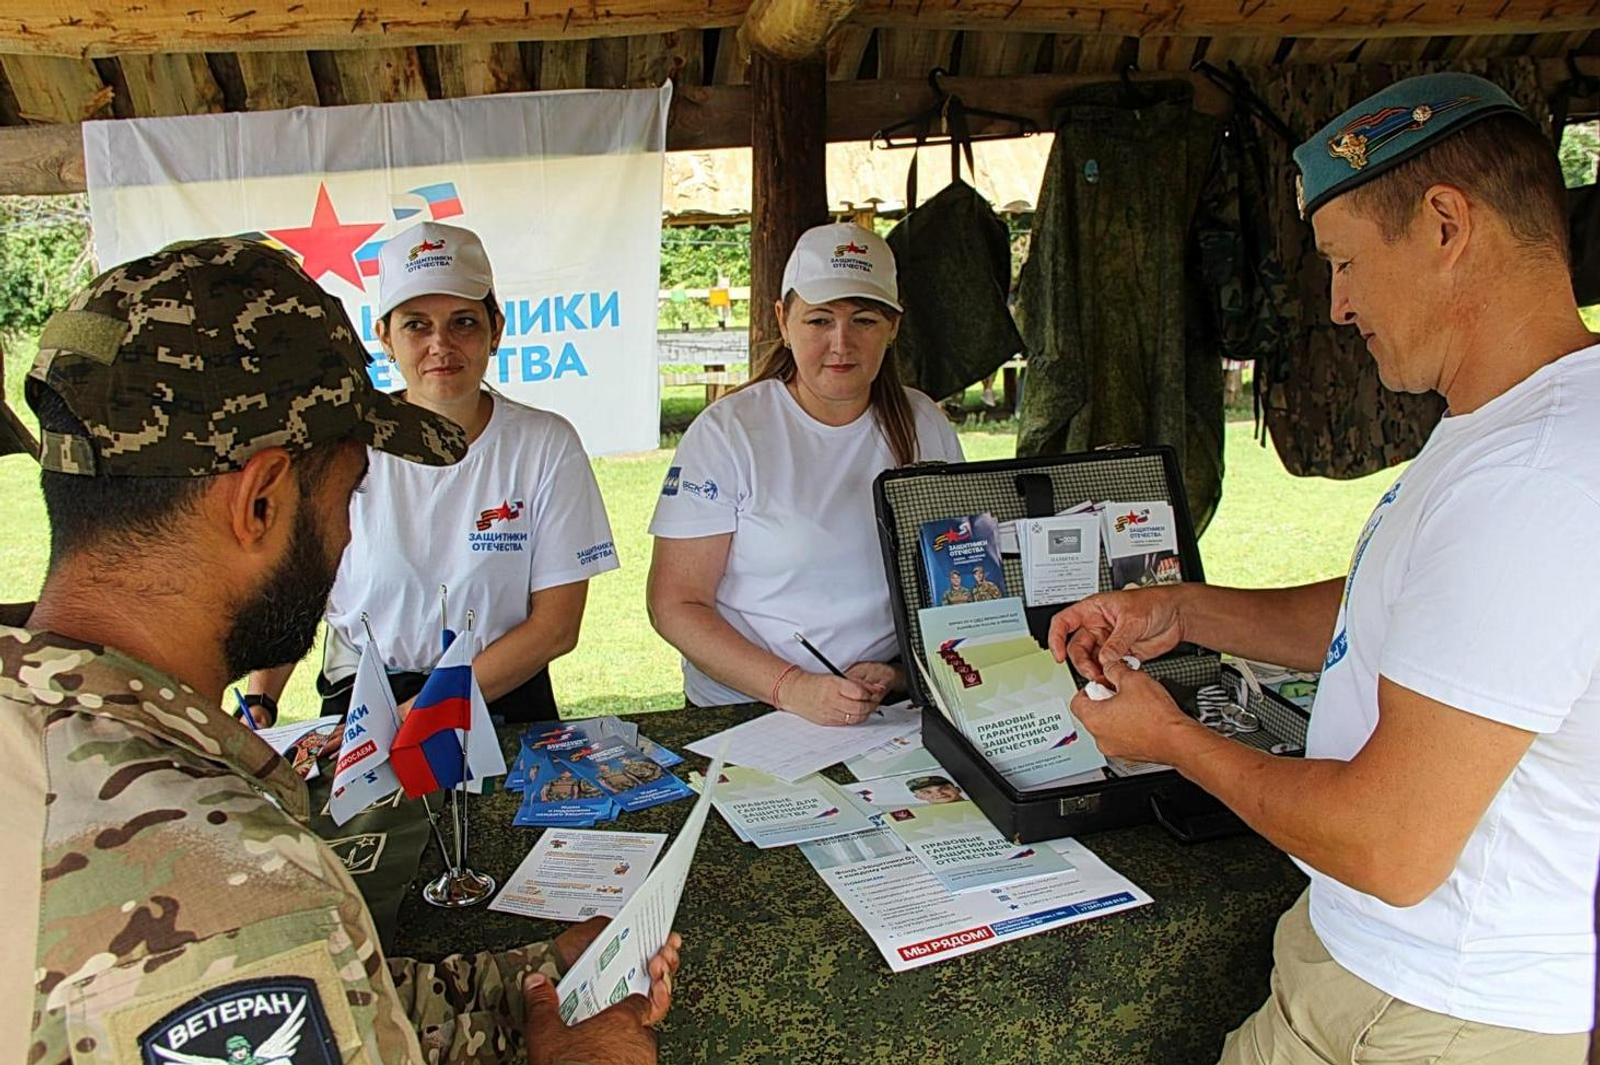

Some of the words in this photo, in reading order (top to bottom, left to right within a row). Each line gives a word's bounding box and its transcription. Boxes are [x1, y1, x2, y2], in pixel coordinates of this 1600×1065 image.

[468, 532, 528, 542] ЗАЩИТНИКИ
[472, 542, 524, 551] ОТЕЧЕСТВА
[576, 542, 614, 559] ЗАЩИТНИКИ
[580, 550, 614, 565] ОТЕЧЕСТВА
[977, 712, 1037, 733] ПРАВОВЫЕ
[980, 720, 1036, 741] ГАРАНТИИ
[1038, 714, 1062, 725] ДЛЯ
[982, 724, 1060, 749] ЗАЩИТНИКОВ
[985, 736, 1048, 757] ОТЕЧЕСТВА
[733, 797, 791, 809] ПРАВОВЫЕ
[737, 802, 794, 814] ГАРАНТИИ
[796, 798, 819, 806] ДЛЯ
[742, 804, 818, 819] ЗАЩИТНИКОВ
[745, 811, 808, 824] ОТЕЧЕСТВА
[921, 836, 982, 850] ПРАВОВЫЕ
[926, 842, 987, 856] ГАРАНТИИ
[930, 843, 1012, 860] ЗАЩИТНИКОВ
[936, 851, 1003, 866] ОТЕЧЕСТВА
[903, 941, 930, 959] МЫ
[933, 928, 990, 952] РЯДОМ!
[167, 993, 293, 1050] ВЕТЕРАН
